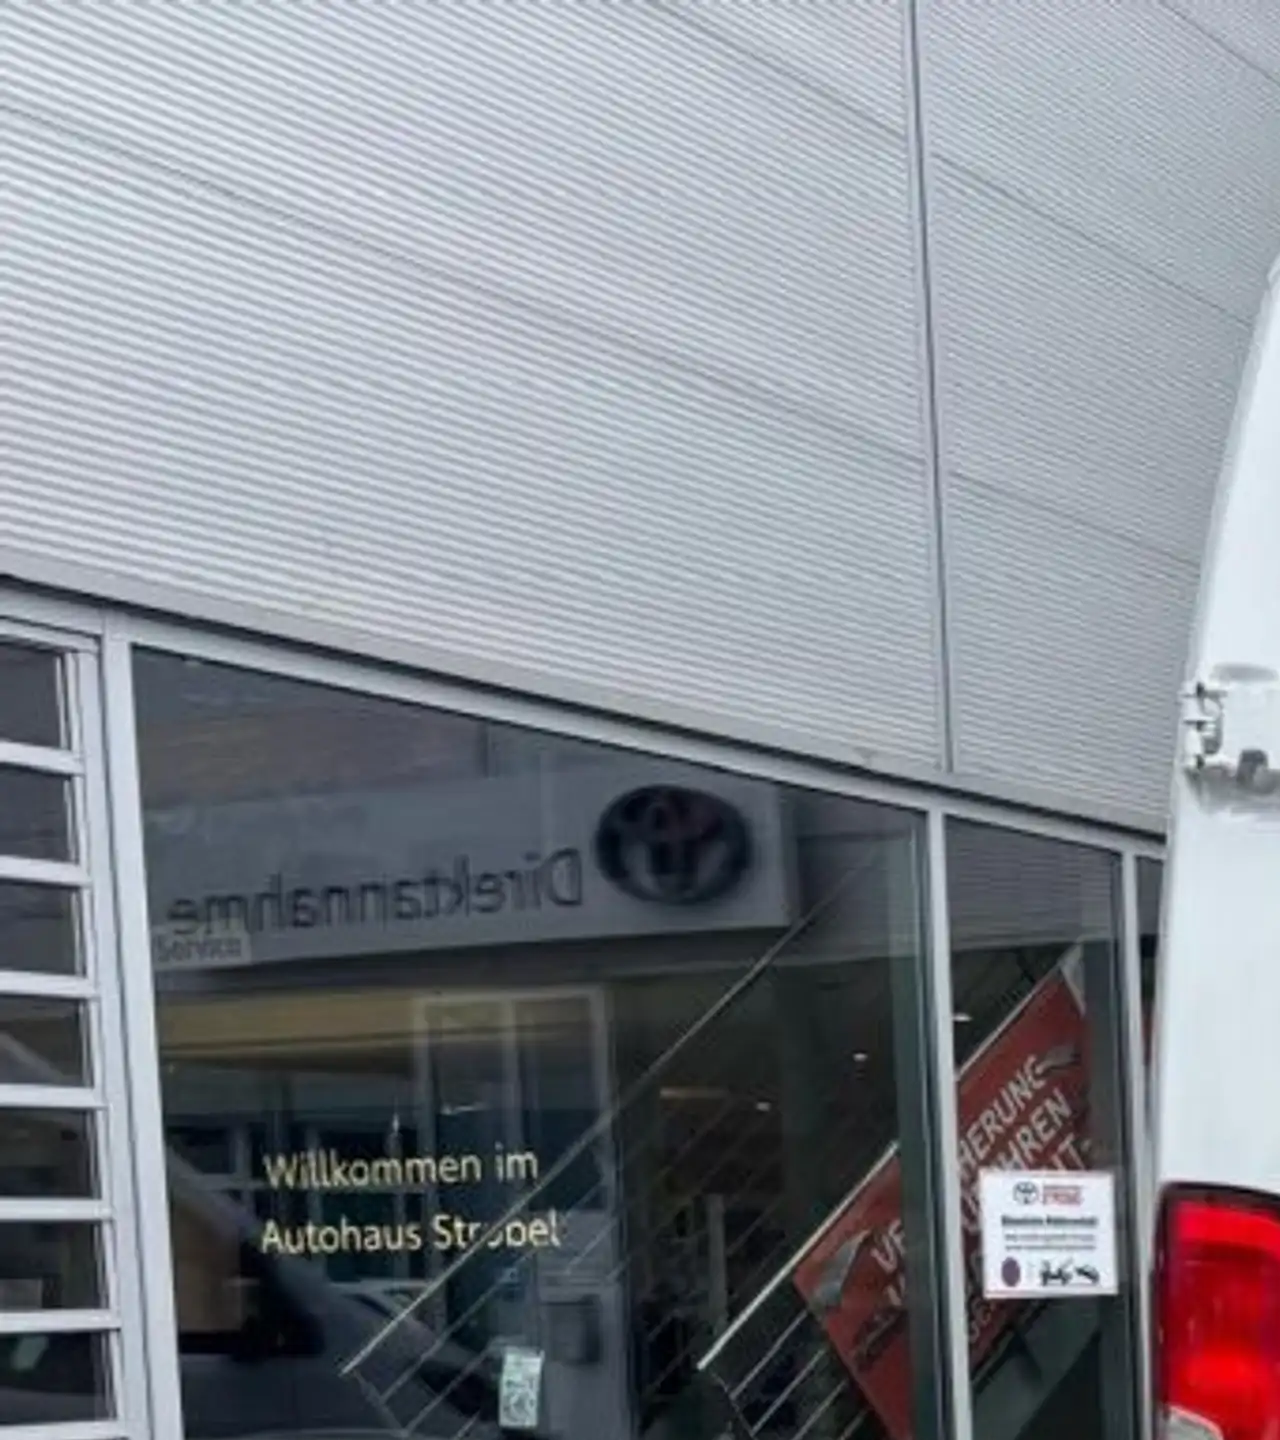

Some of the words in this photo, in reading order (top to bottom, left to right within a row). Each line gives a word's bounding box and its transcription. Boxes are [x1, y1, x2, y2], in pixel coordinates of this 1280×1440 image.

[262, 1148, 482, 1190] Willkommen
[495, 1141, 539, 1182] im
[261, 1214, 422, 1254] Autohaus
